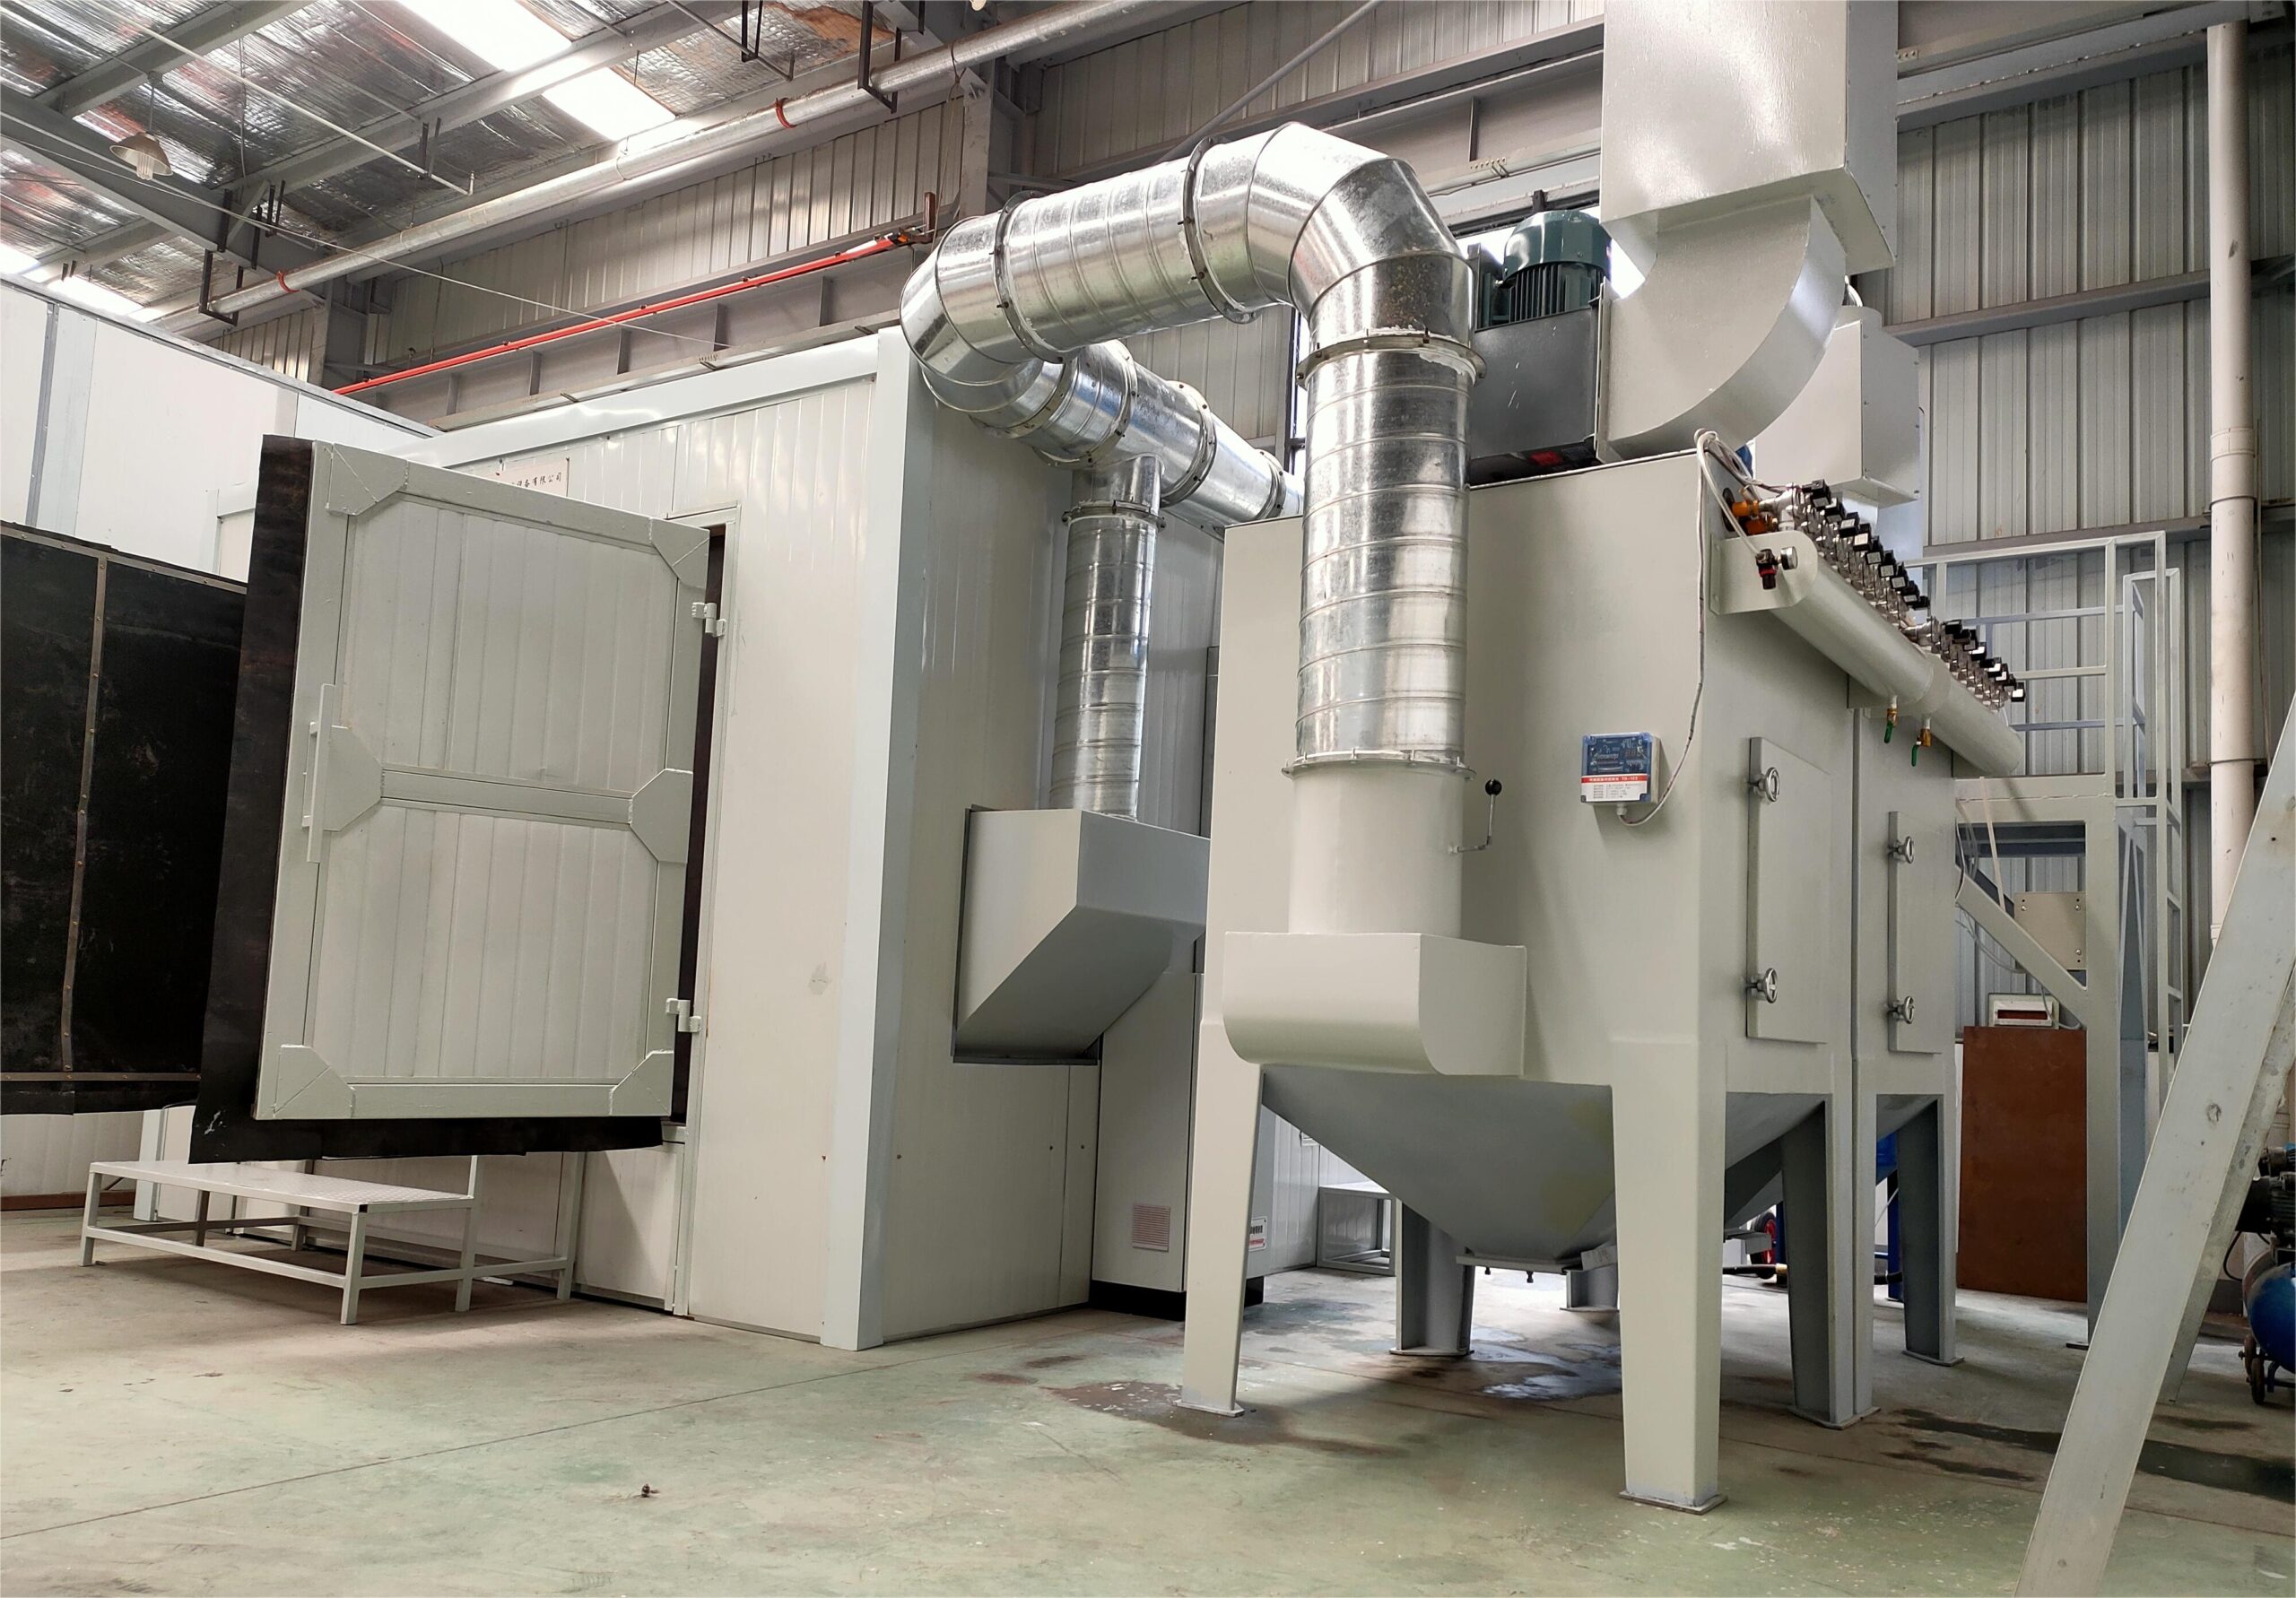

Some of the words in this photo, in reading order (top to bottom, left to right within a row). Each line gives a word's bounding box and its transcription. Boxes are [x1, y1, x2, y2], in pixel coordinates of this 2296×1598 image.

[512, 472, 561, 488] 设备有限公司
